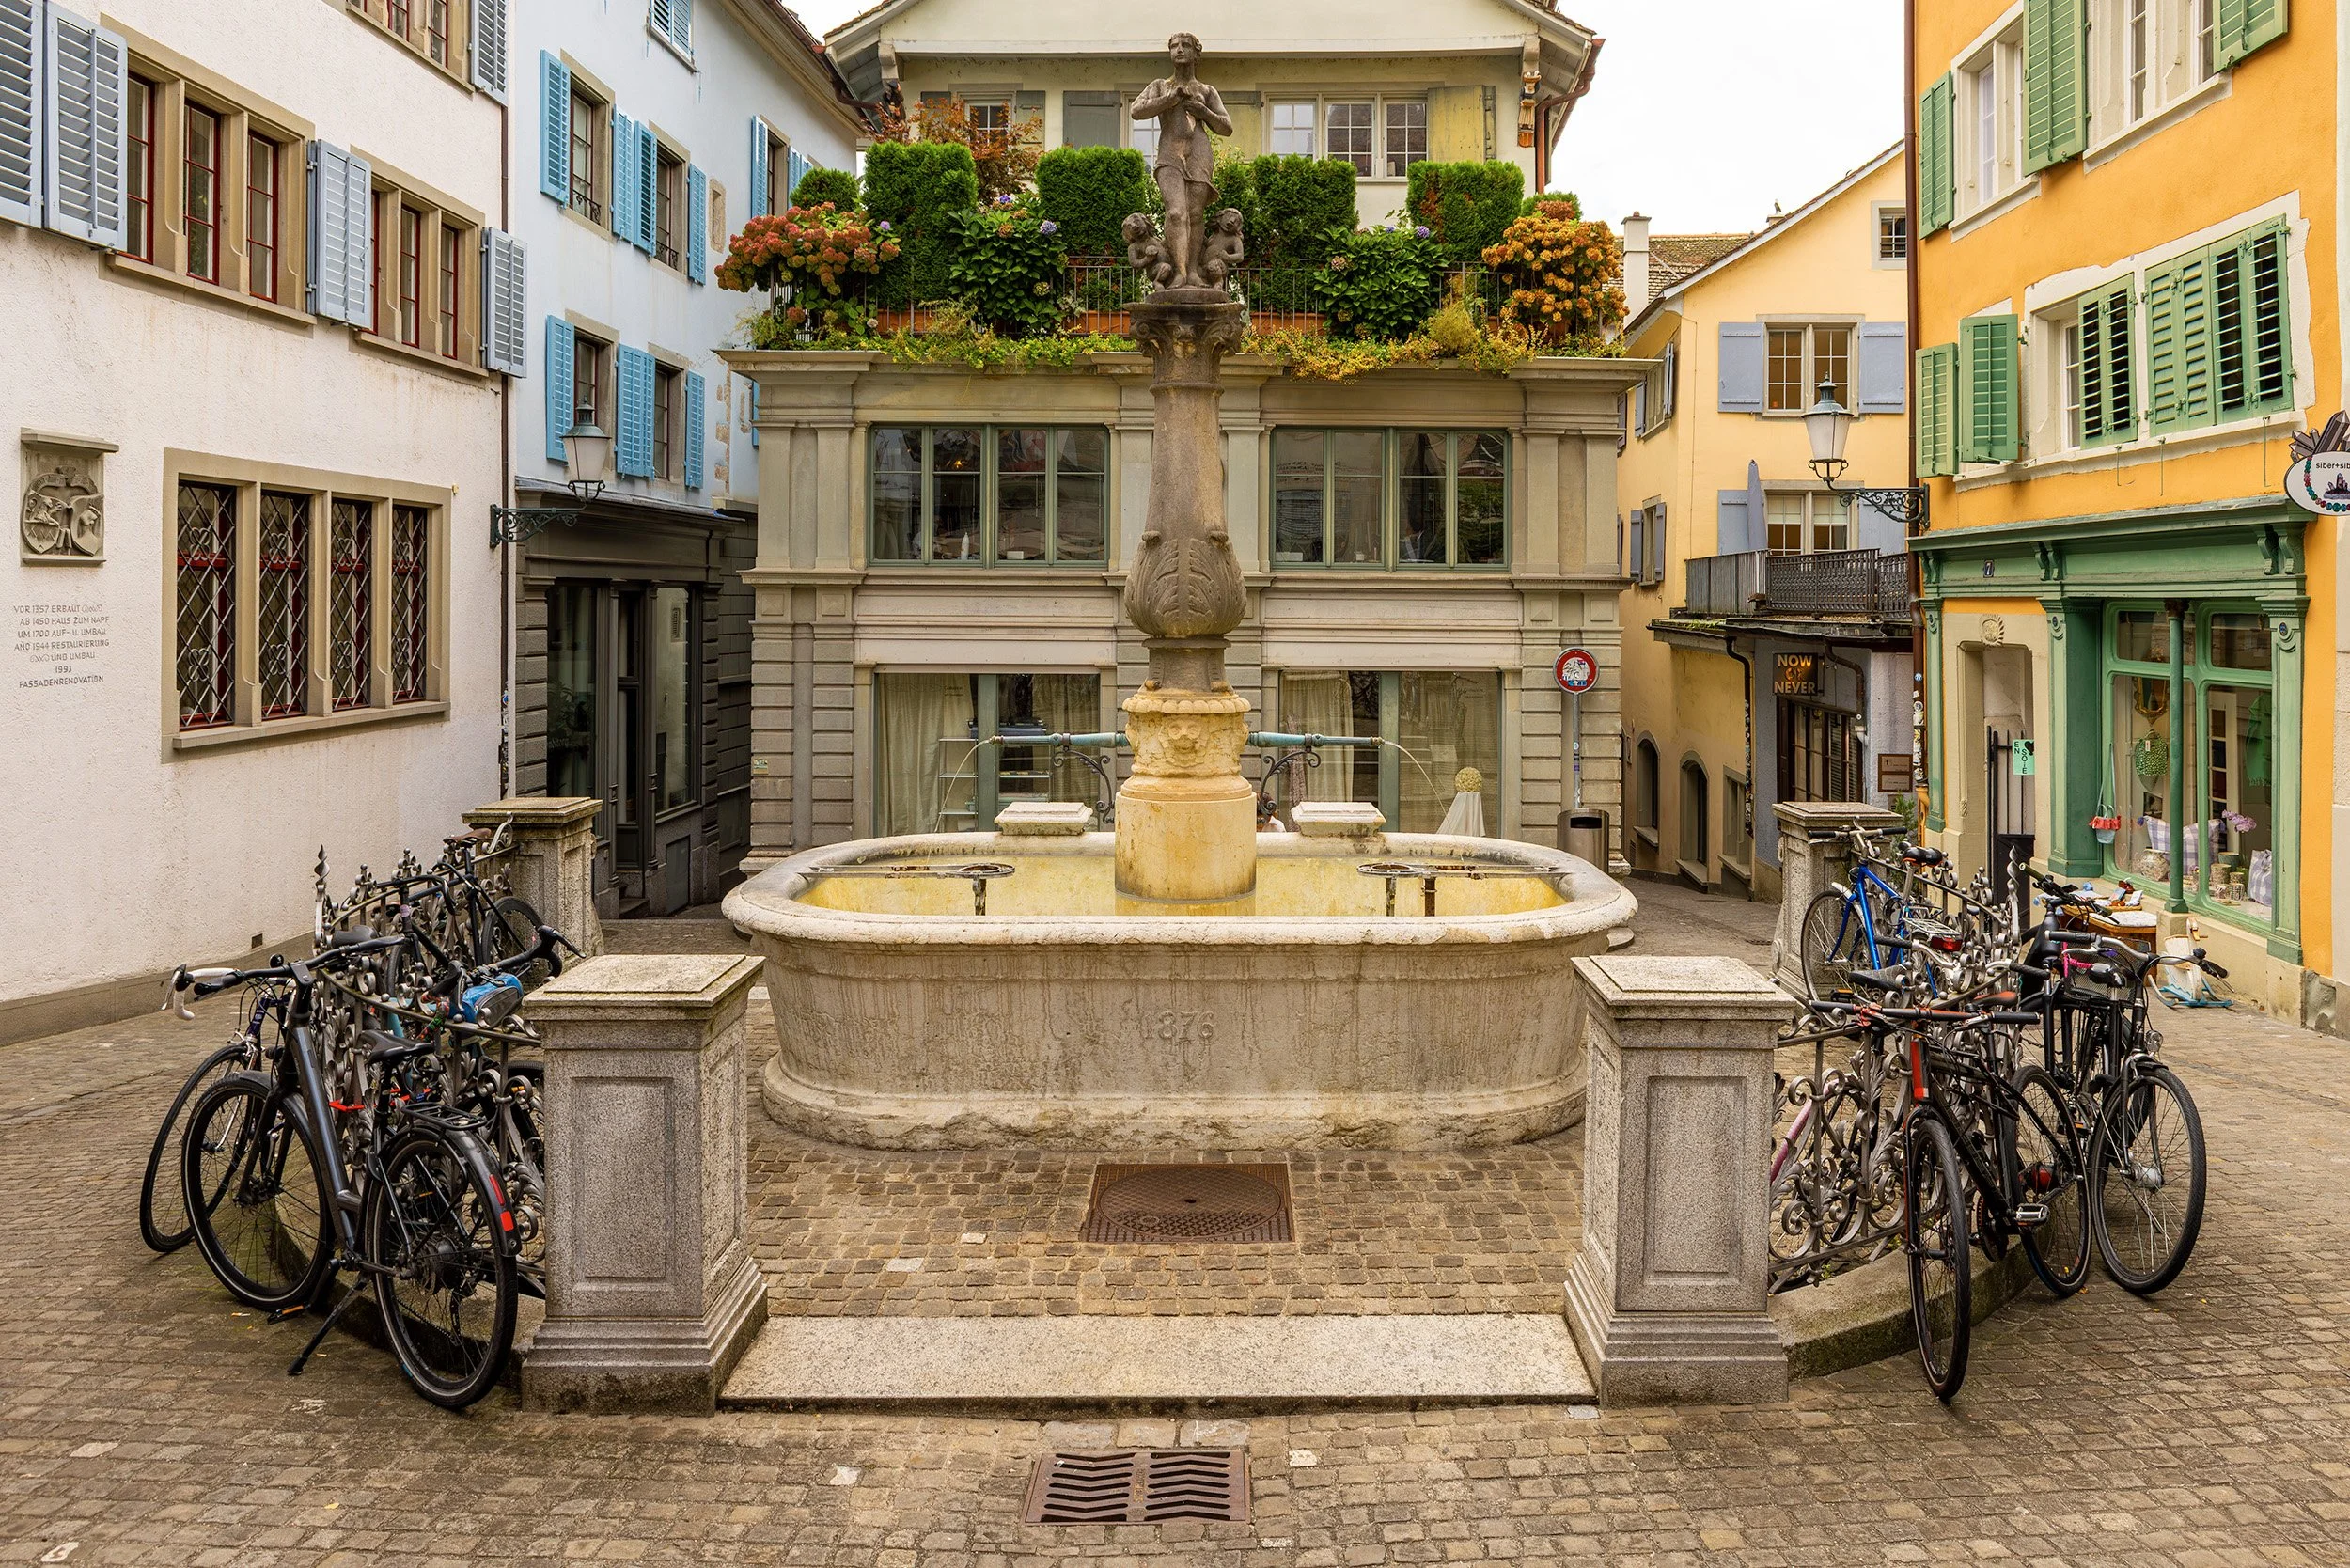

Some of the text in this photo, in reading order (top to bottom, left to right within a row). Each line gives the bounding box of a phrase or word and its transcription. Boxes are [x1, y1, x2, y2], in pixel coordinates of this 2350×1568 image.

[51, 604, 81, 613] ERBAUT
[20, 618, 30, 626] AB
[51, 617, 71, 625] HAUS
[73, 616, 90, 624] ZUM
[91, 616, 110, 624] NAPF
[17, 630, 31, 638] UM
[32, 630, 50, 638] 1700
[51, 629, 70, 637] AUF-
[51, 639, 110, 649] RESTAURIERUNG
[51, 651, 96, 662] UND UMBAU
[1778, 654, 1812, 667] NOW
[19, 675, 104, 688] FASSADENRENOVATION
[1774, 681, 1815, 694] NEVER
[2013, 741, 2020, 754] EN
